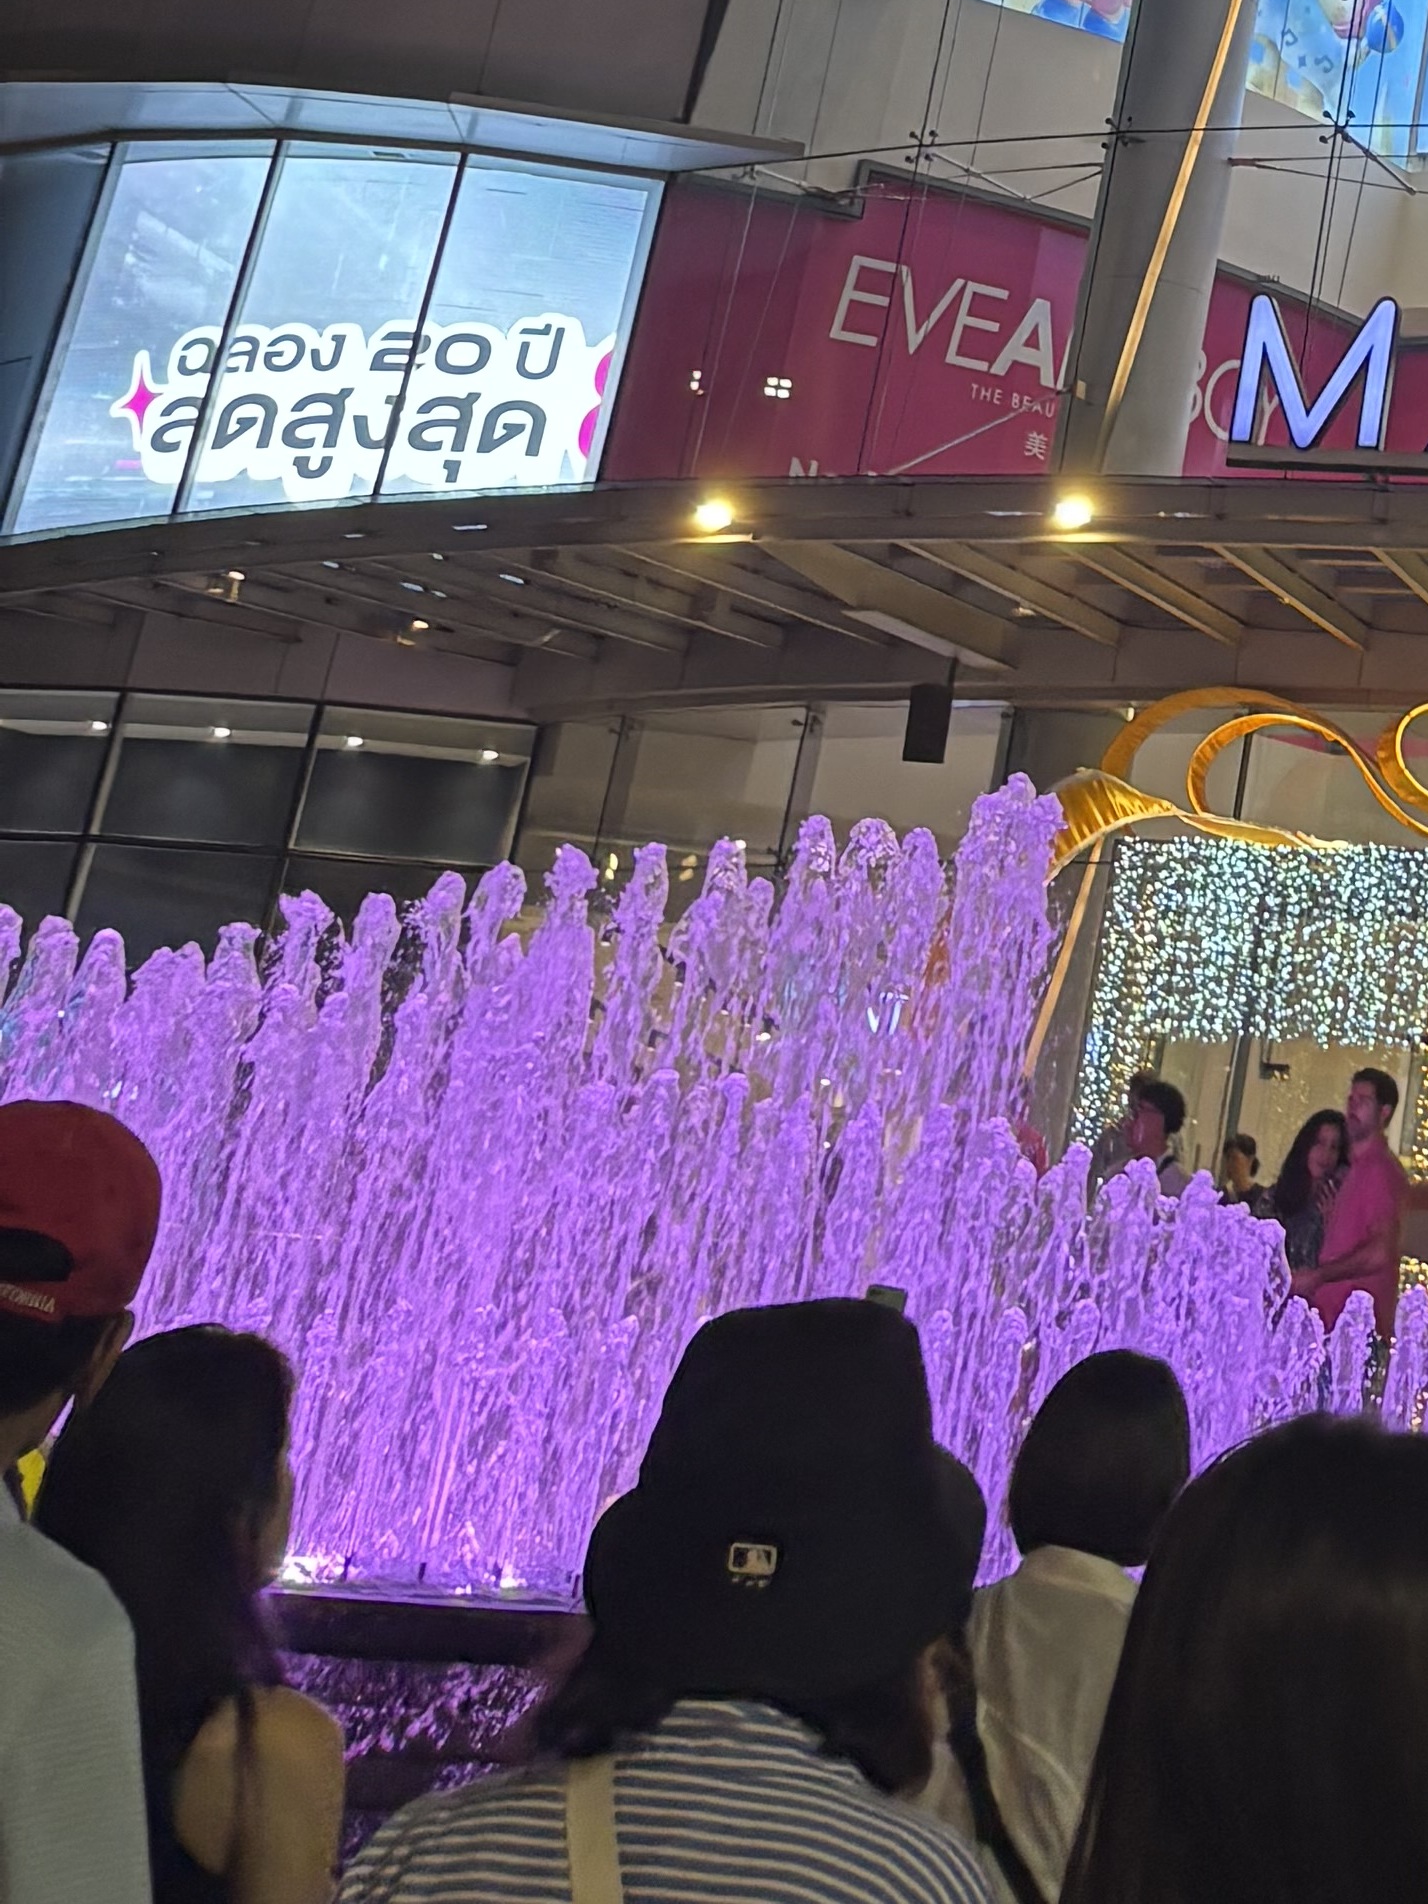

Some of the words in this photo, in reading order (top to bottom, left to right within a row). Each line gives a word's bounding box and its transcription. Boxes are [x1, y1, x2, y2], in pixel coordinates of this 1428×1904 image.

[176, 330, 346, 377] ฉลอง
[515, 322, 566, 381] ปี
[829, 254, 1075, 390] EVEA
[971, 383, 1002, 405] THE
[149, 385, 548, 484] ลดสูงสุด
[1024, 430, 1048, 460] 美
